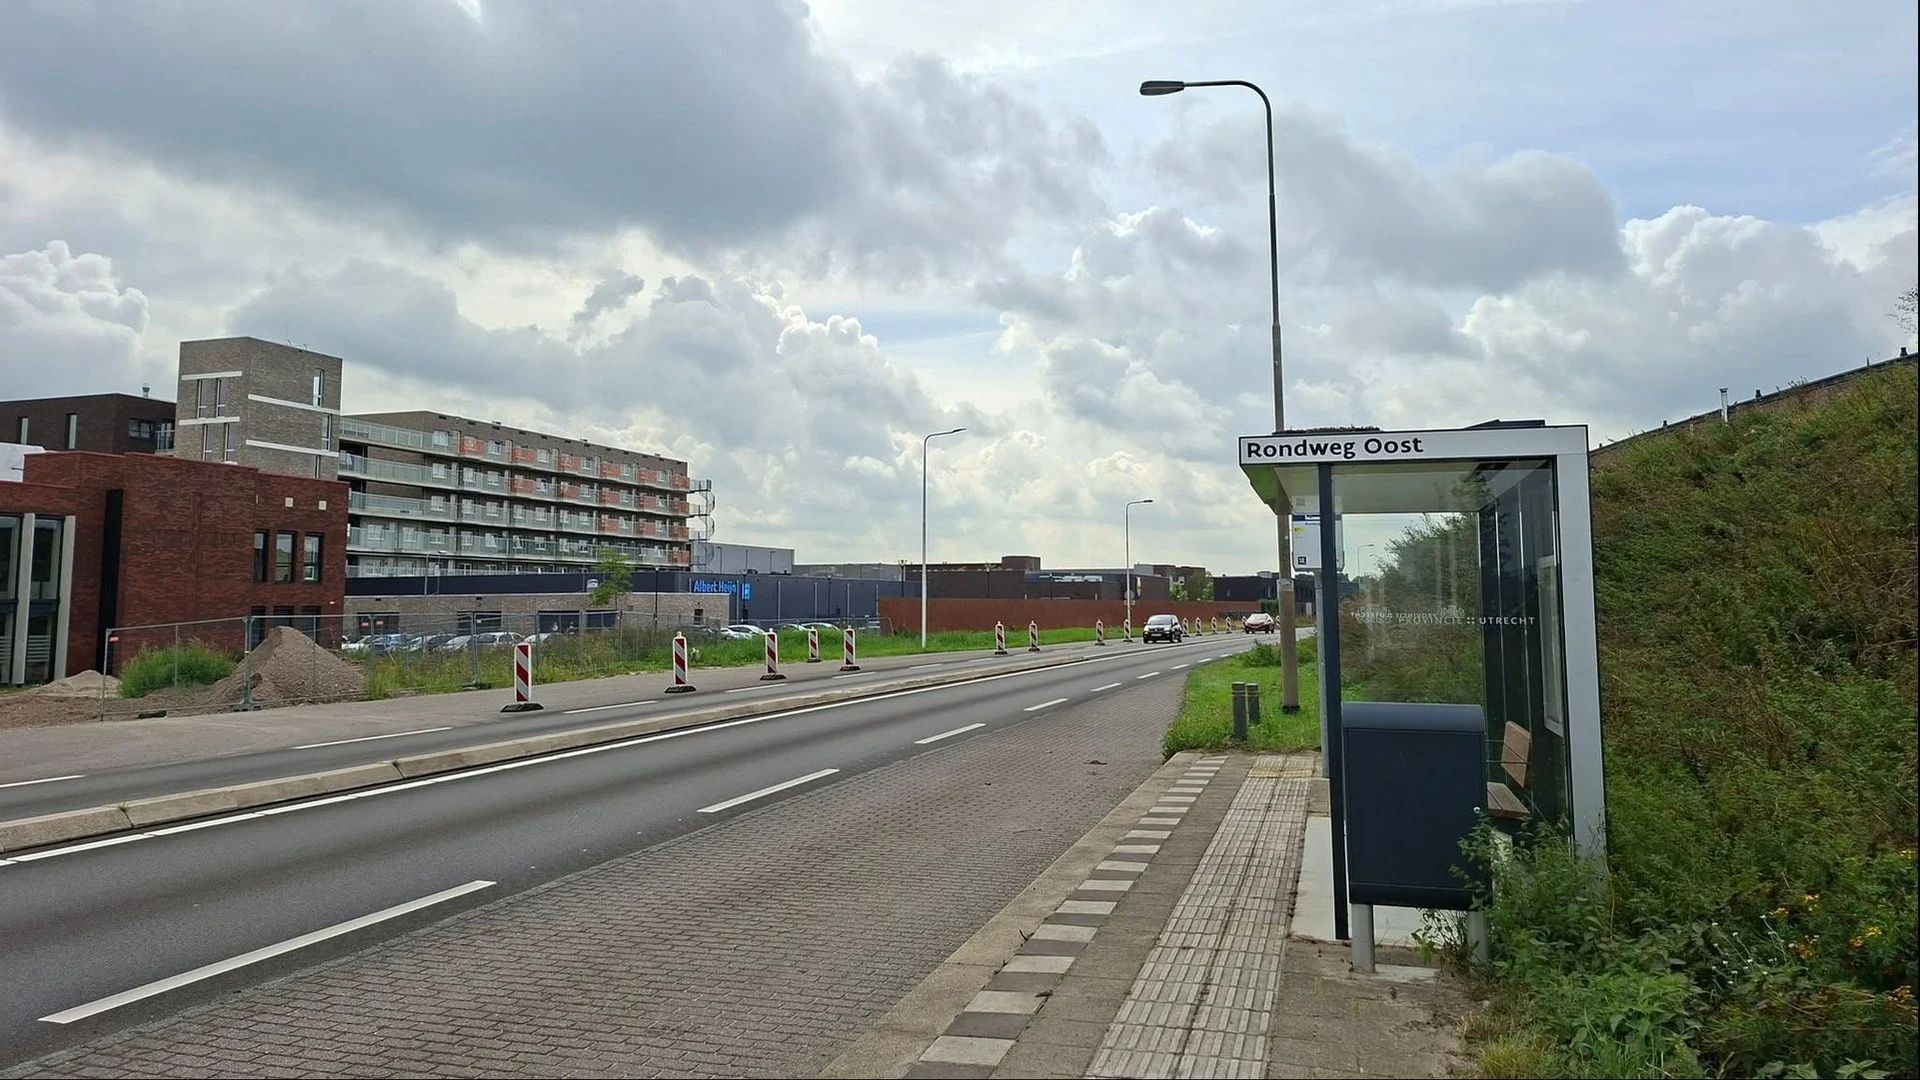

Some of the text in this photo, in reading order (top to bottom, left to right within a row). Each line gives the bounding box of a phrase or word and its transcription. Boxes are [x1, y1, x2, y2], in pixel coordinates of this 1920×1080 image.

[1247, 438, 1424, 459] Rondweg Oost
[693, 580, 718, 592] Albert
[1479, 616, 1535, 625] UTRECHT
